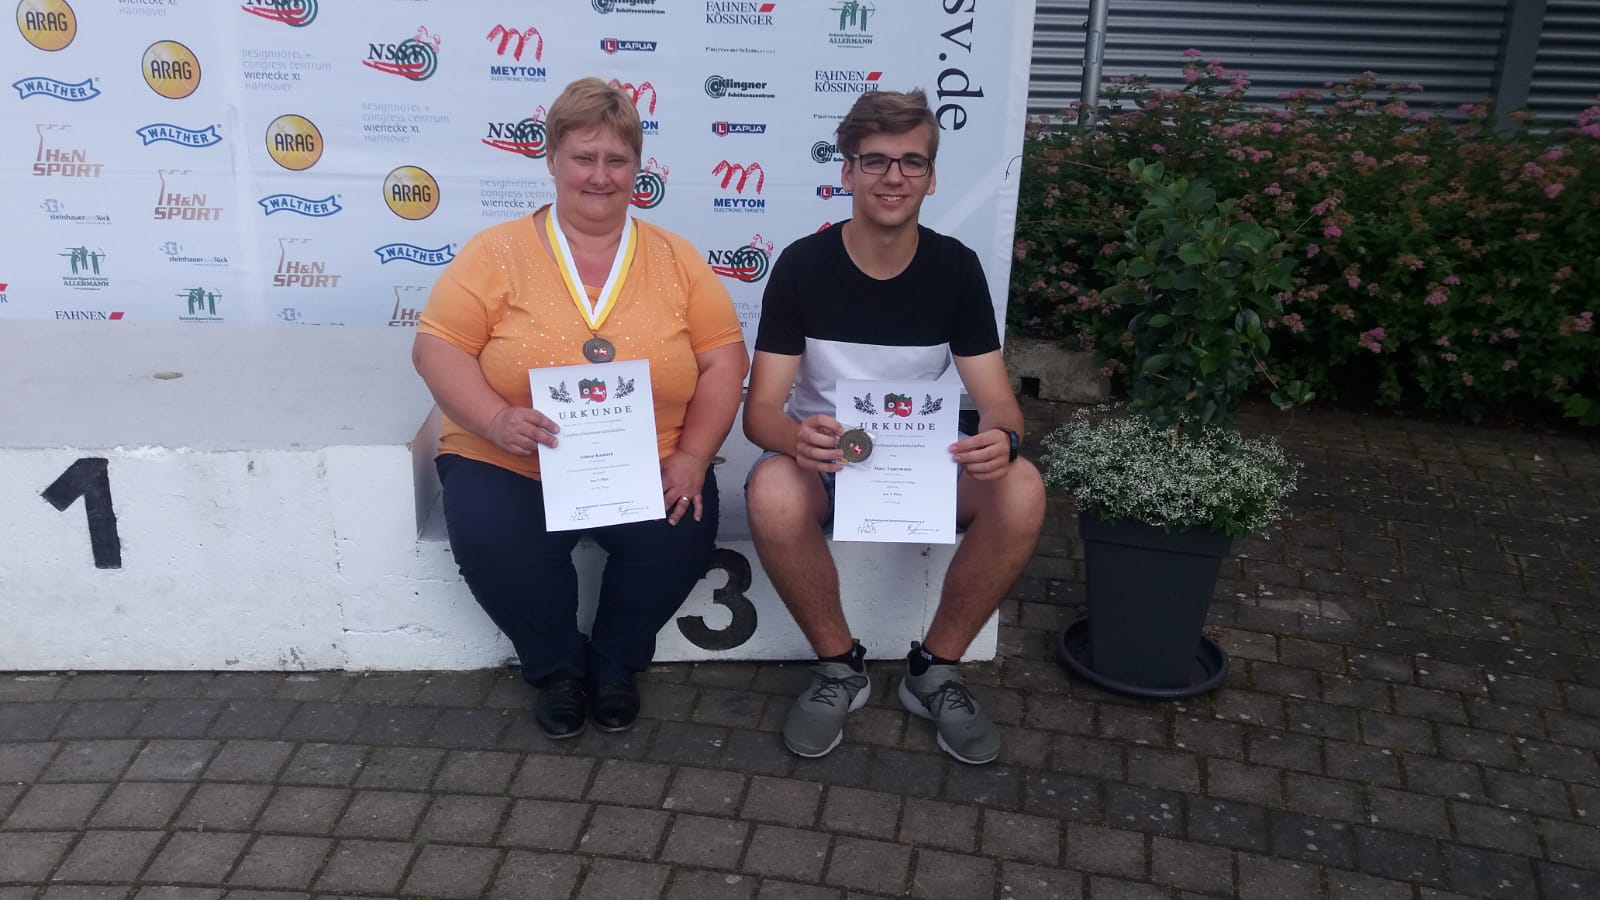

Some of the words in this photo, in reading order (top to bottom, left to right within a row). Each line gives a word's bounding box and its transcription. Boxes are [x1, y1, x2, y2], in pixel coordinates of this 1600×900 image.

[706, 1, 758, 12] FAHNEN
[25, 11, 68, 31] ARAG
[706, 12, 774, 25] KÖSSINGER
[619, 42, 654, 50] LAPUA
[151, 60, 192, 79] ARAG
[244, 70, 289, 80] wienecke
[490, 66, 546, 77] MEYTON
[815, 70, 865, 81] FAHNEN
[24, 81, 87, 98] WALTHER
[719, 79, 767, 91] Klingner
[363, 122, 408, 133] wienecke
[148, 127, 209, 143] WALTHER
[274, 133, 315, 152] ARAG
[45, 149, 86, 163] H&N
[33, 163, 104, 178] SPORT
[166, 193, 206, 206] H&N
[392, 184, 431, 202] ARAG
[525, 190, 556, 199] centru
[270, 198, 329, 213] WALTHER
[481, 198, 524, 208] wienecke
[713, 198, 765, 207] MEYTON
[154, 207, 223, 221] SPORT
[386, 247, 445, 262] WALTHER
[286, 261, 326, 274] H&N
[273, 275, 342, 288] SPORT
[55, 311, 107, 320] FAHNEN
[559, 405, 632, 420] URKUNDE
[860, 422, 936, 431] URKUNDE
[40, 457, 121, 569] 1
[677, 549, 758, 651] 3
